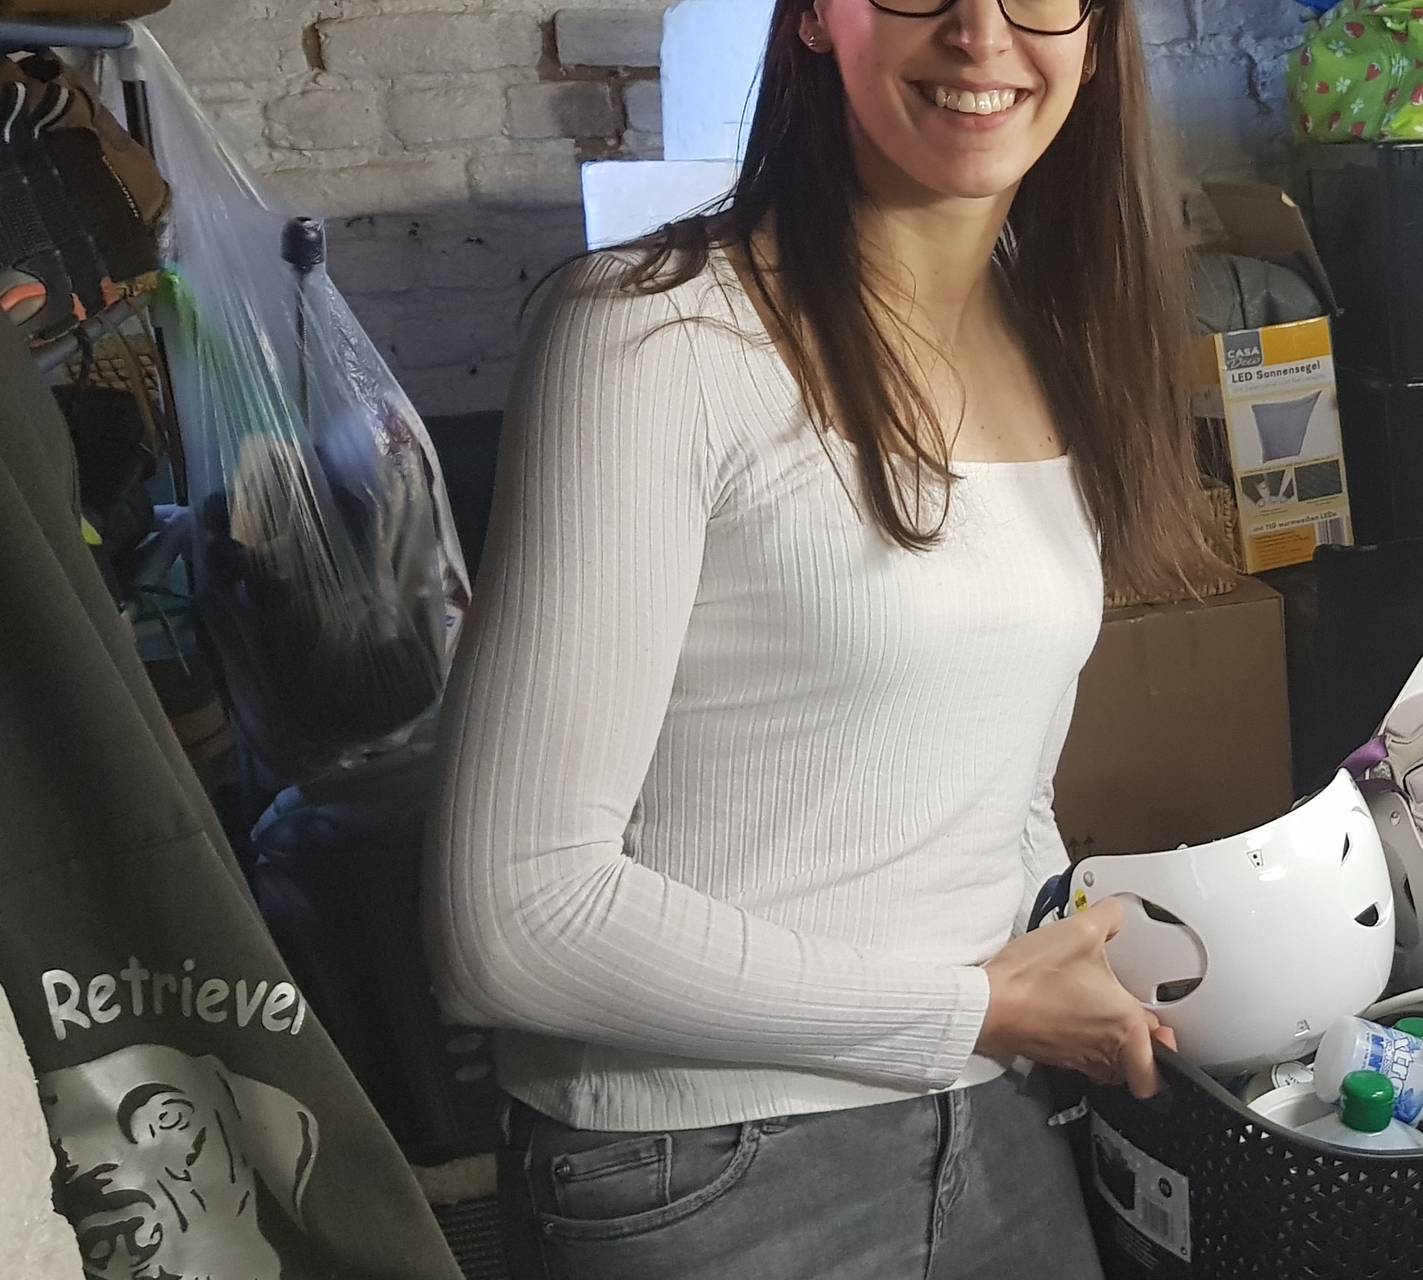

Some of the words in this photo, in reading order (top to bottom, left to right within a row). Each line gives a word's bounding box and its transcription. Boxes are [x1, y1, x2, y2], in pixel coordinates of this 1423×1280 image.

[1228, 346, 1259, 359] CASA
[1231, 372, 1253, 384] LED
[1256, 360, 1320, 380] Sonnensegel
